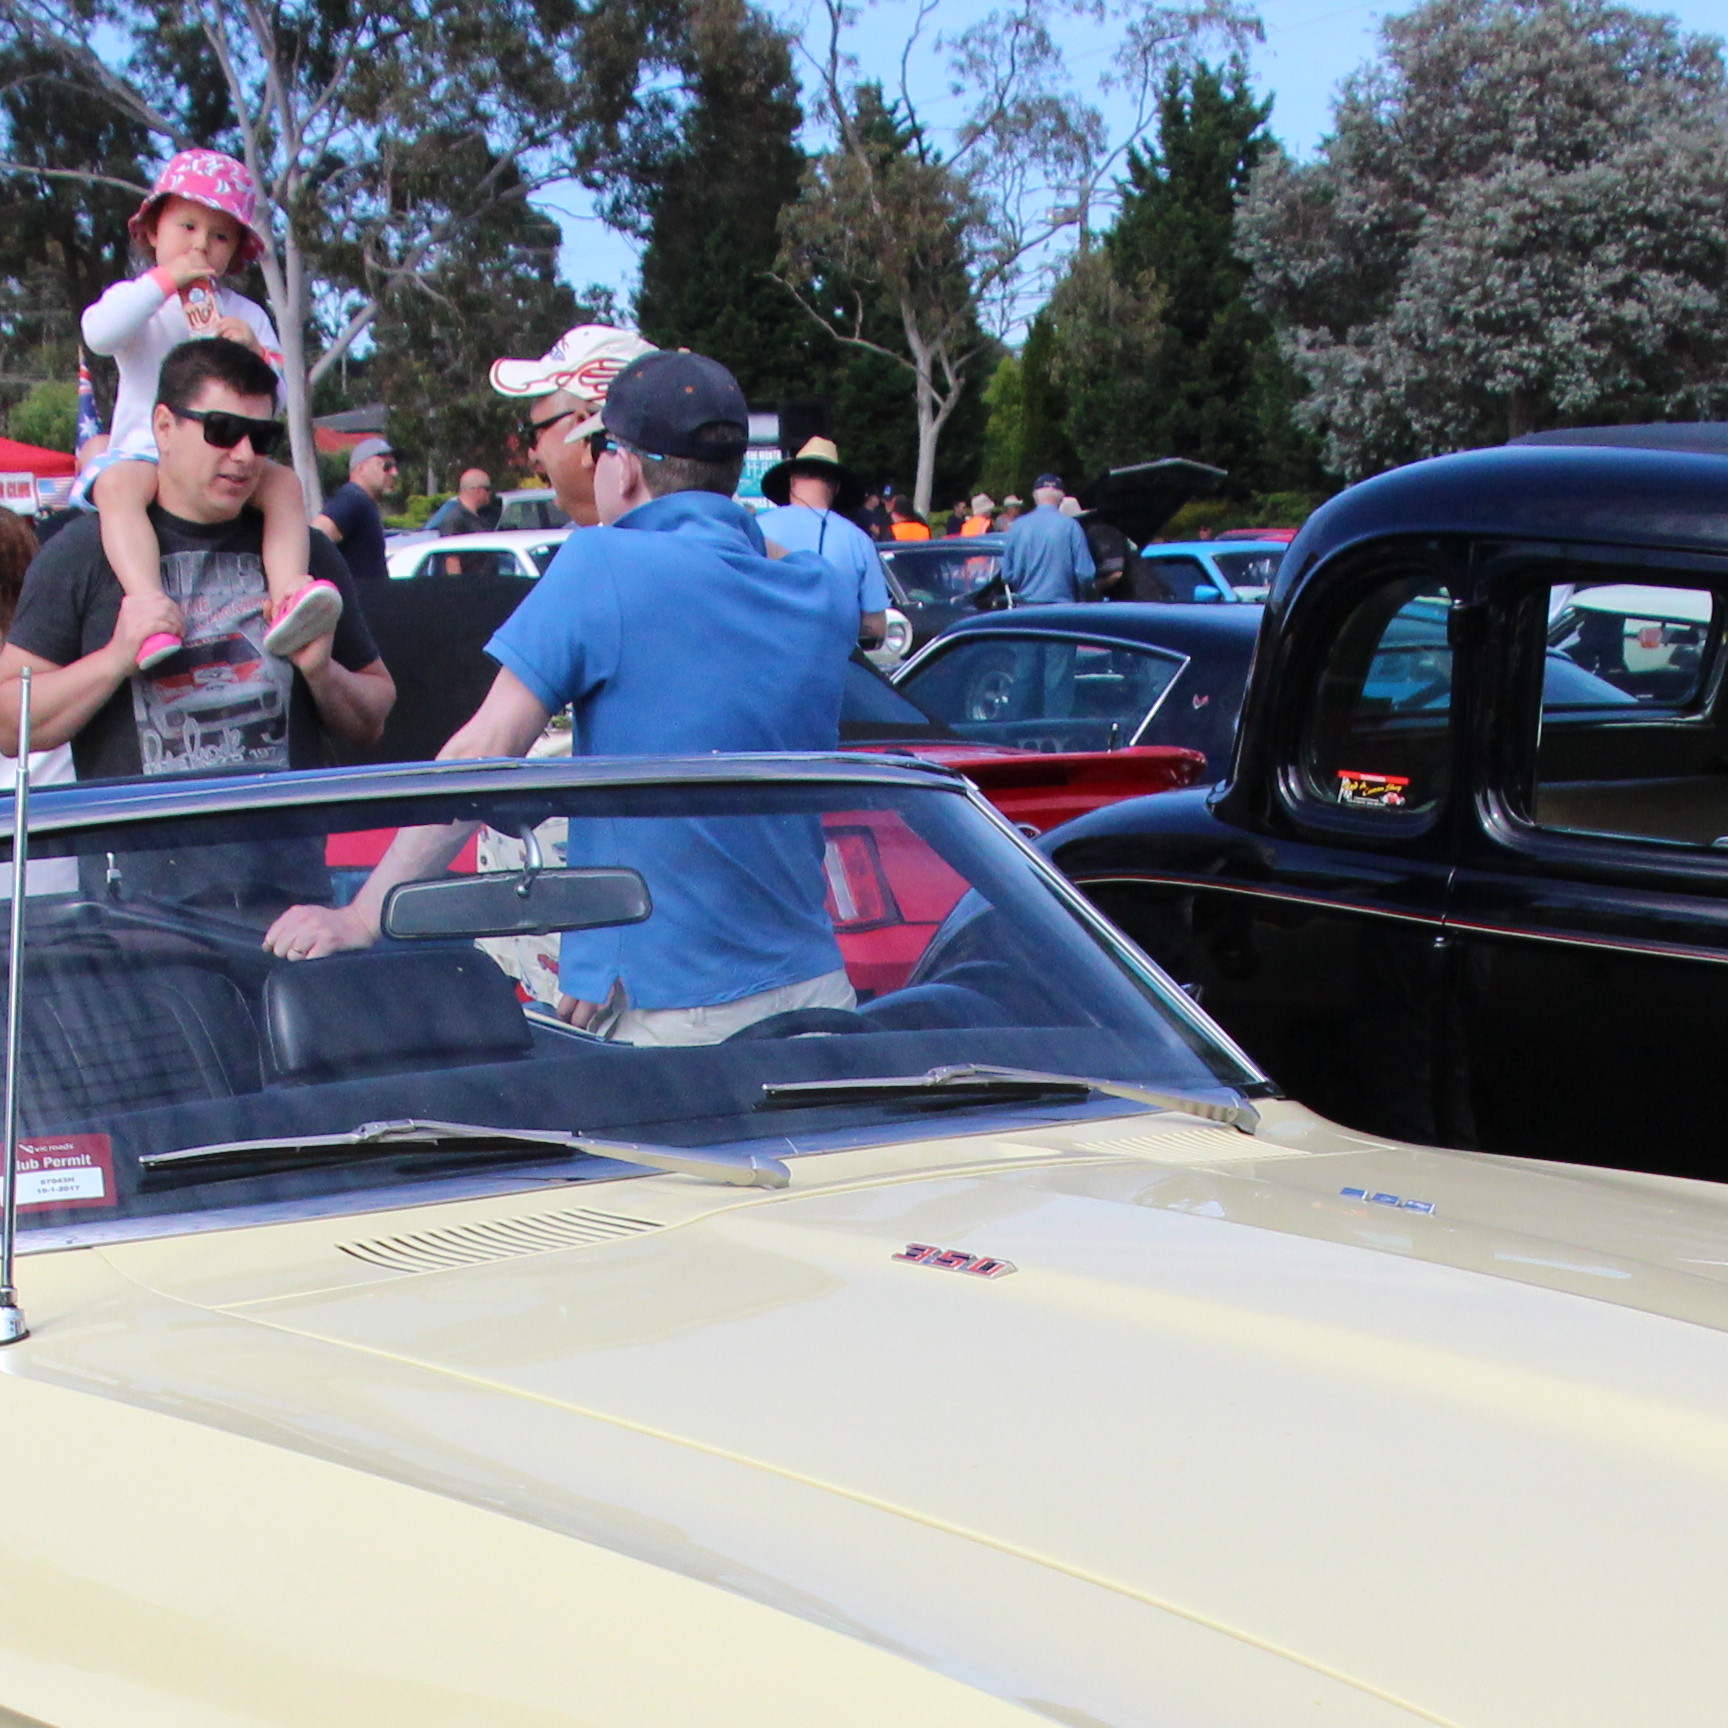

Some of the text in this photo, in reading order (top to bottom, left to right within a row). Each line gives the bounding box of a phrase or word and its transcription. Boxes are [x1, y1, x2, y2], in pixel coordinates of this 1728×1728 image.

[7, 481, 31, 498] CLUB
[15, 1154, 92, 1172] lub Permit
[891, 1242, 1012, 1278] 350
